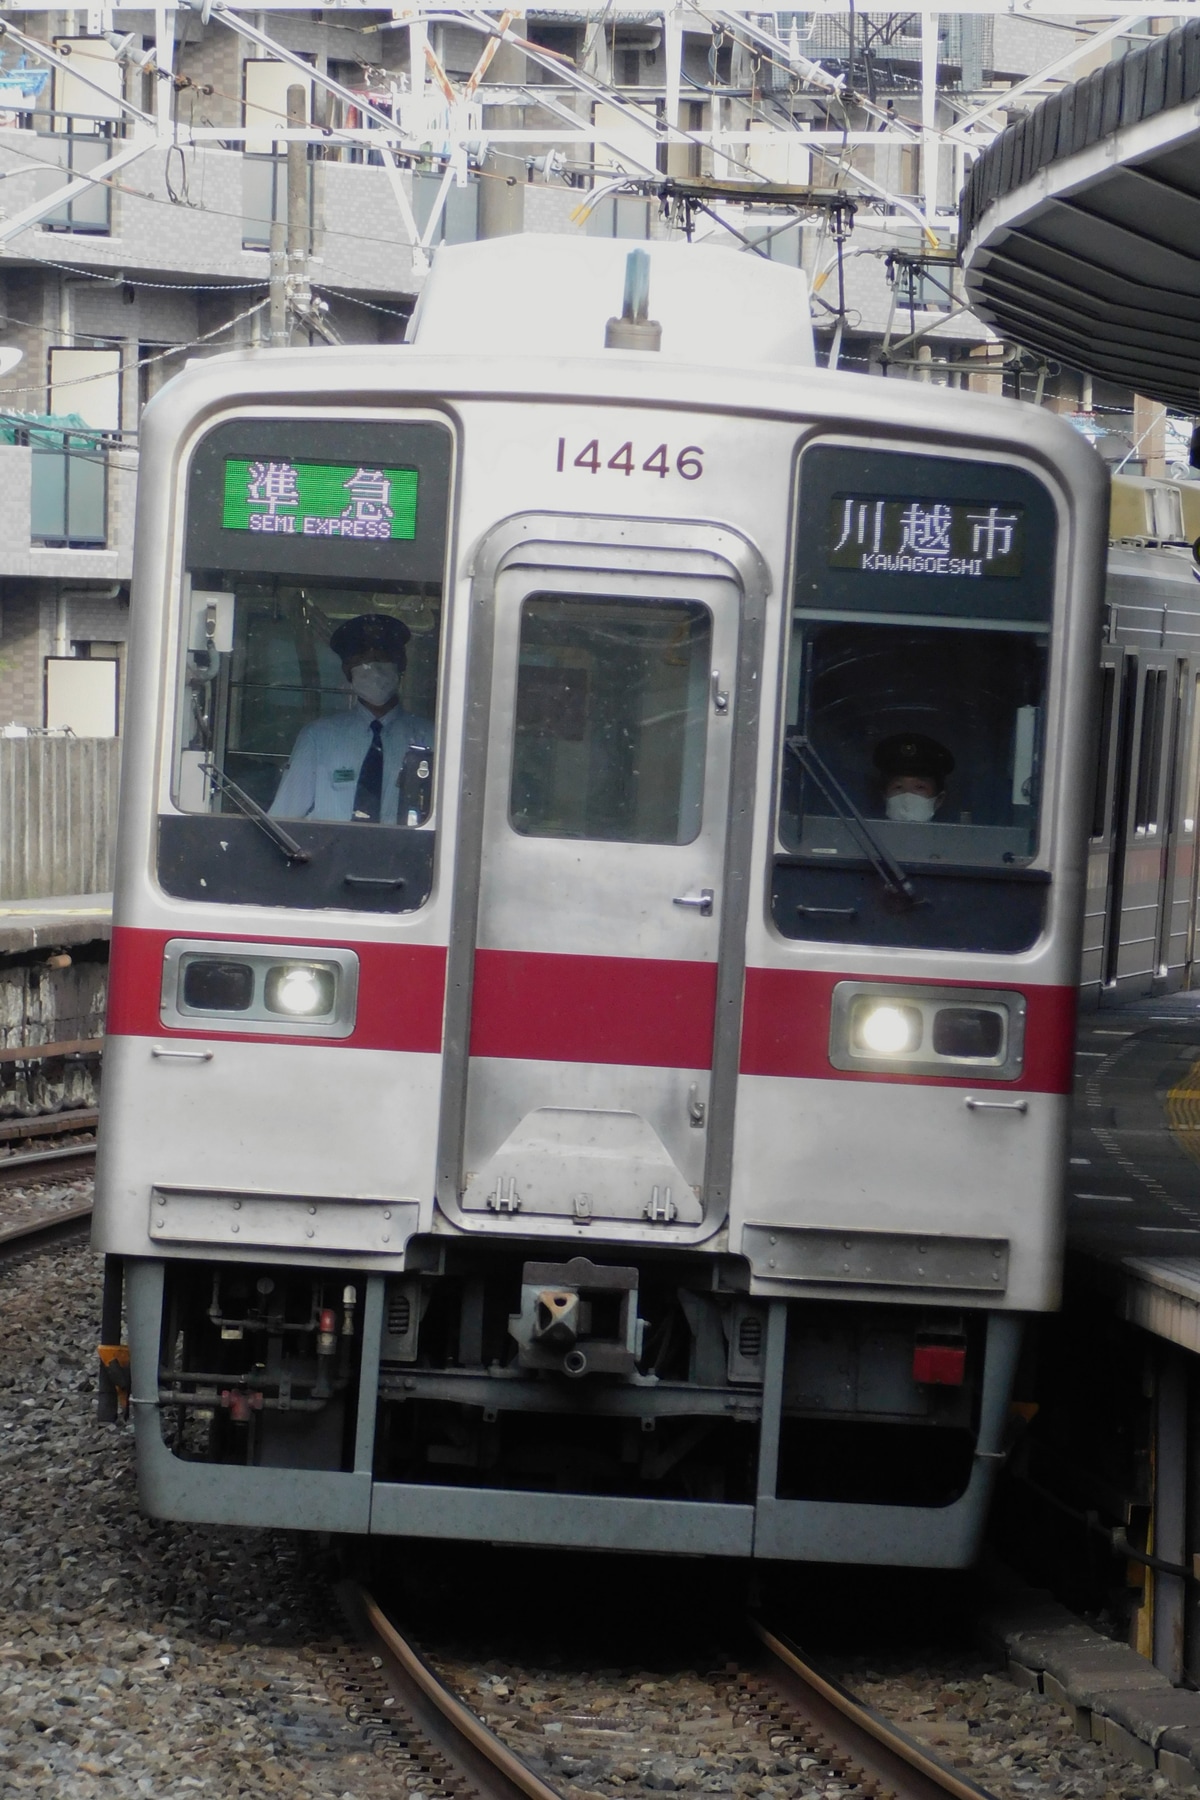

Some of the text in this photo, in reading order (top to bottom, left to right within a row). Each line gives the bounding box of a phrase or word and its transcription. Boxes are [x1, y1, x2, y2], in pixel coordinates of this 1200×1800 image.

[556, 437, 705, 481] 14446
[247, 461, 394, 520] 準急
[250, 514, 391, 538] SEMI EXPRESS
[834, 499, 1018, 559] 川越市
[862, 553, 982, 576] KAWAGOESHI
